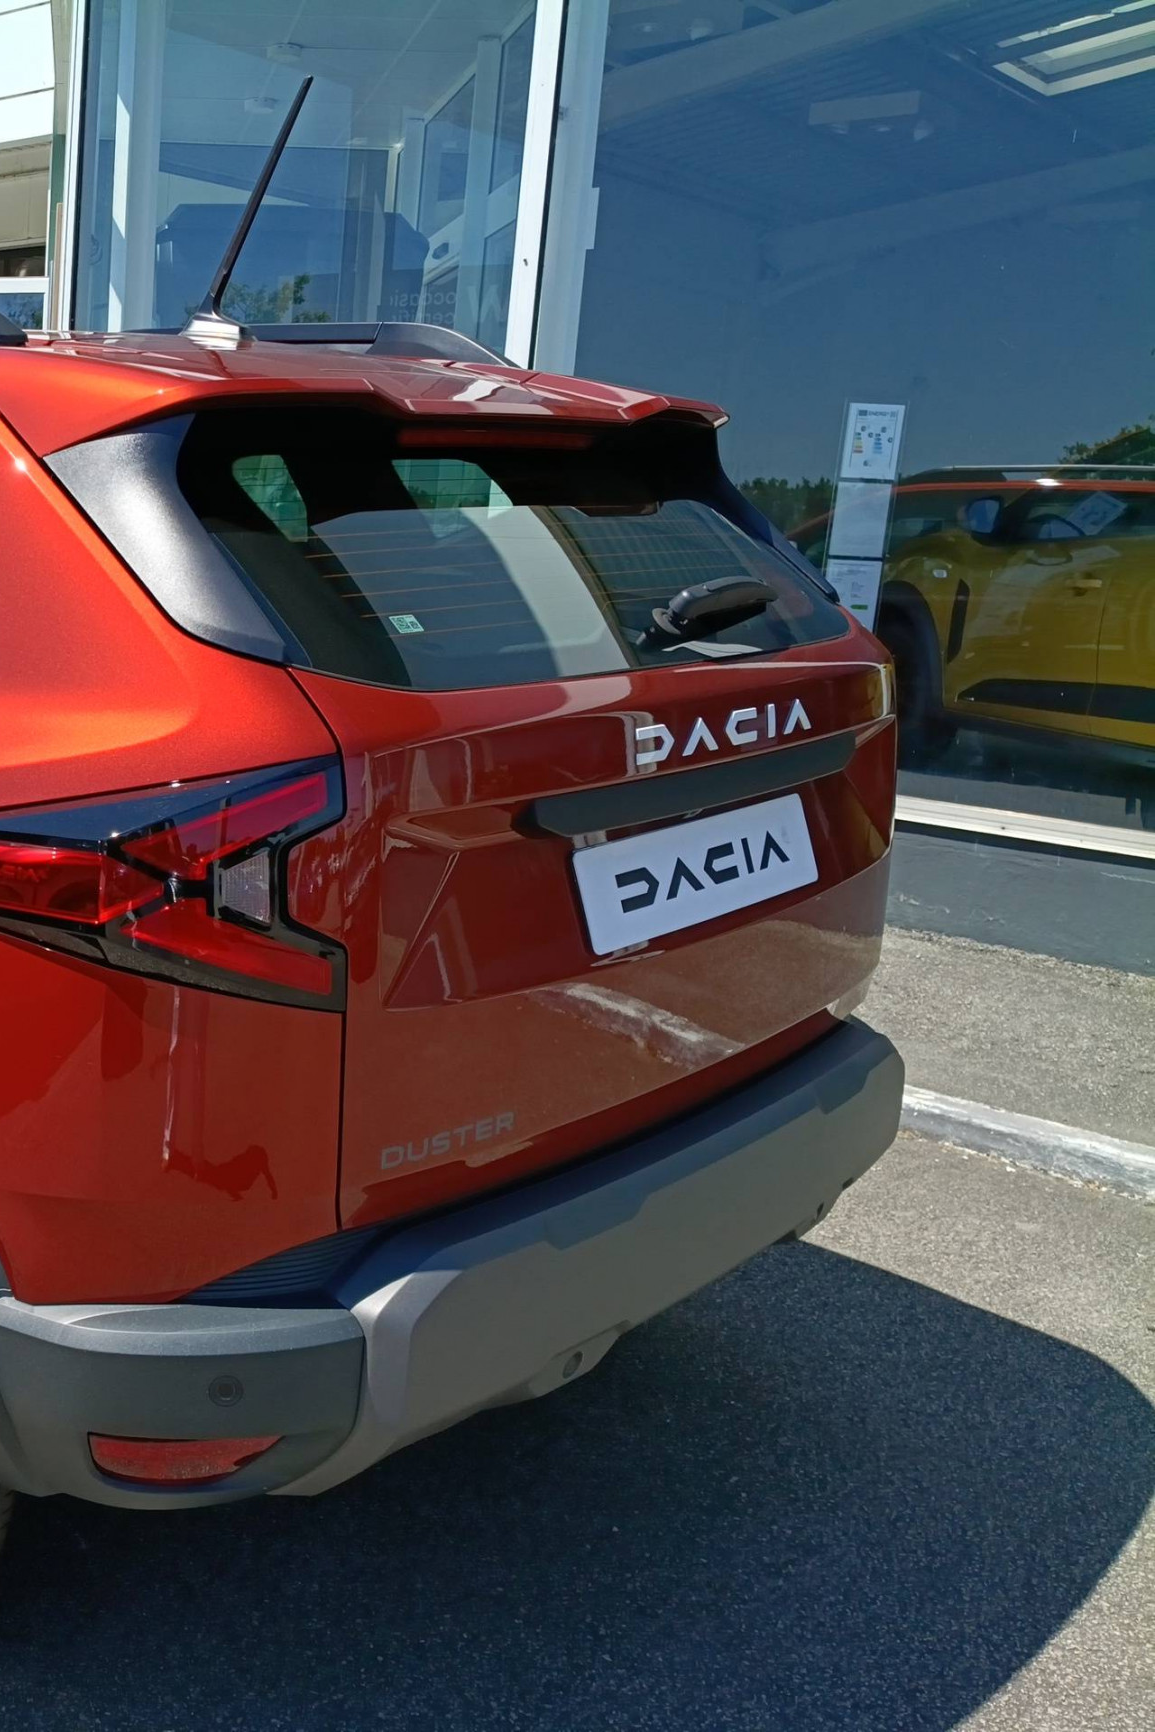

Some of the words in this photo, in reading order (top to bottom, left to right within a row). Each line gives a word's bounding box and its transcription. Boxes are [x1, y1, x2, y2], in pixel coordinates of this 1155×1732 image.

[635, 698, 813, 766] DACIA
[615, 830, 791, 914] DACIA
[380, 1111, 516, 1170] DUSTER
